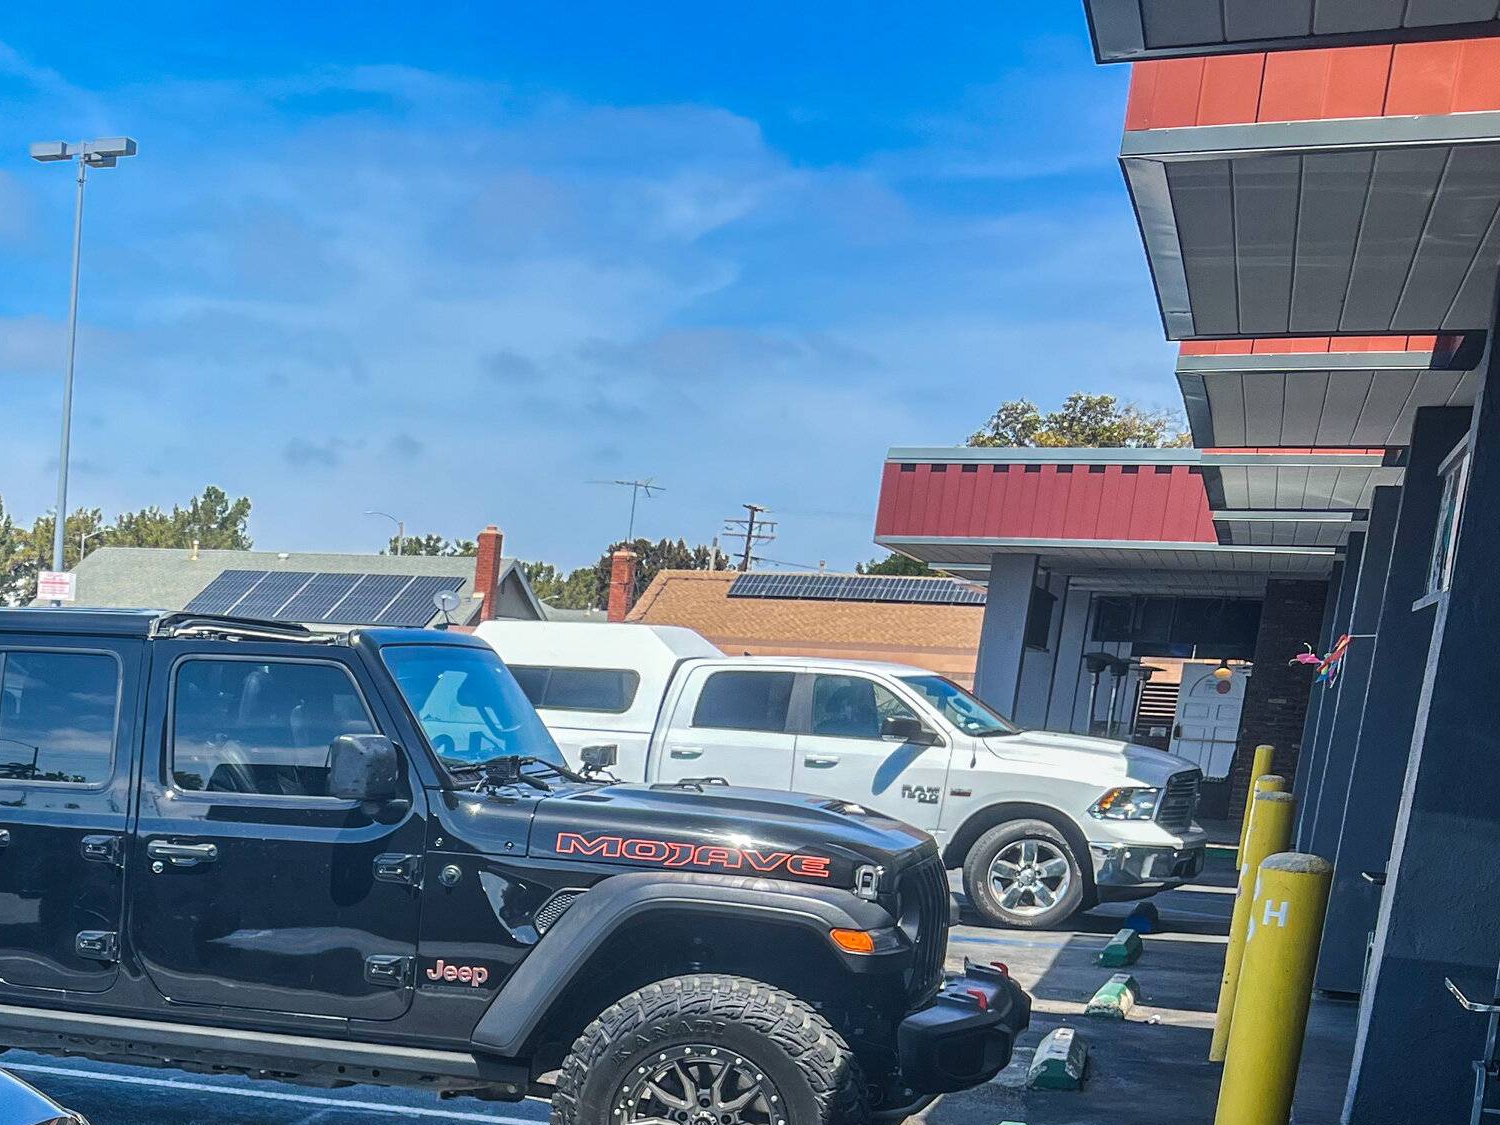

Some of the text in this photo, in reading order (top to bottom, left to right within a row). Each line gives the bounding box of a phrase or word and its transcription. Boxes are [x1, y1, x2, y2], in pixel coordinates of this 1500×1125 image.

[556, 832, 830, 878] MOJAVE
[1262, 899, 1290, 928] H
[426, 959, 489, 988] Jeep
